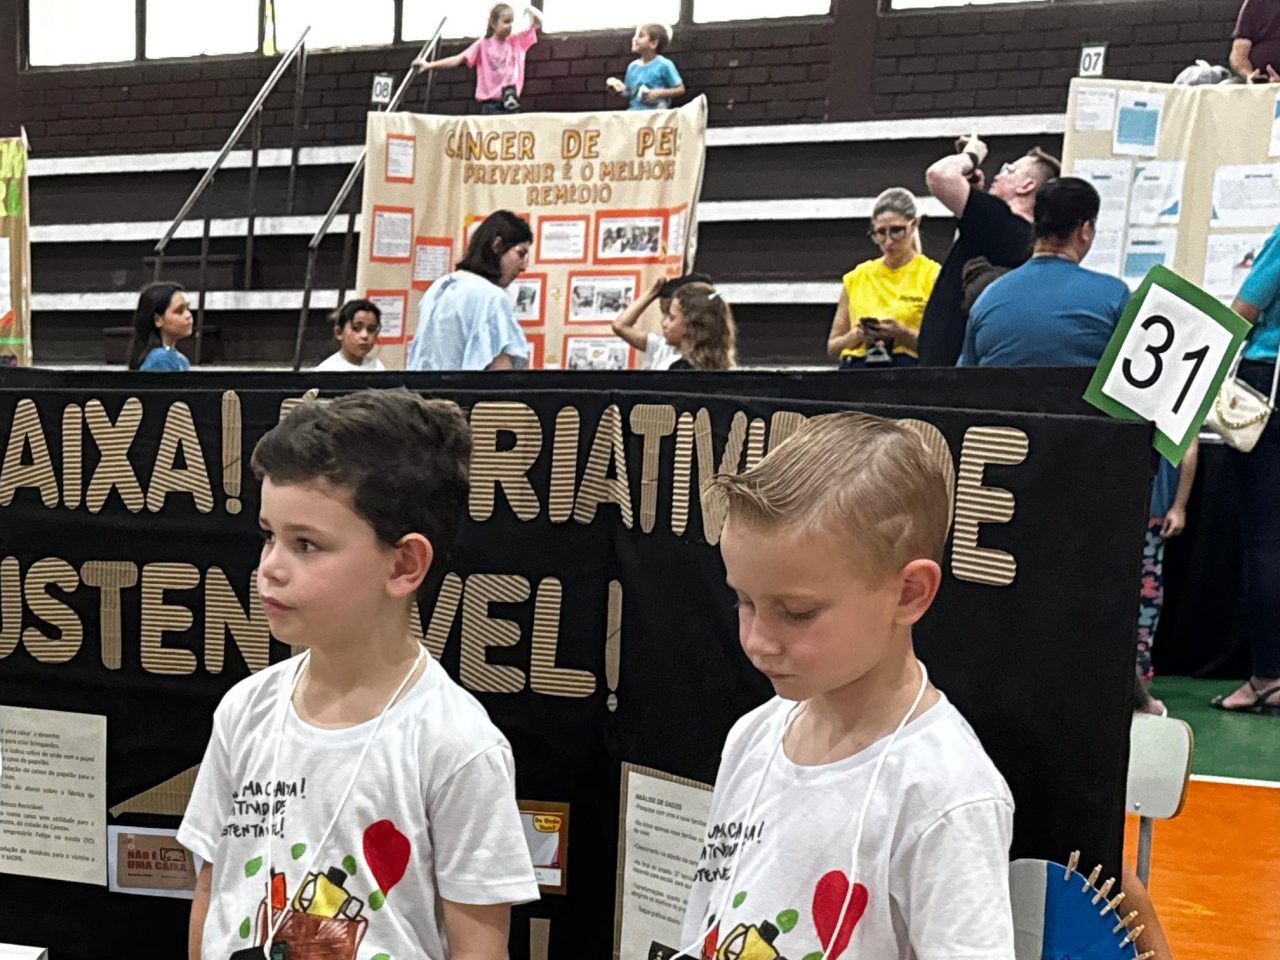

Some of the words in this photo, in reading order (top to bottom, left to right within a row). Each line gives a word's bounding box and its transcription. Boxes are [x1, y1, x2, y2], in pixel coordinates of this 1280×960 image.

[1081, 52, 1102, 73] 07
[375, 80, 390, 99] 08
[562, 128, 600, 160] DE
[637, 127, 679, 157] PE
[464, 163, 555, 184] PREVENIR
[563, 159, 571, 181] É
[580, 162, 593, 181] O
[599, 160, 675, 182] MELHOR
[527, 183, 611, 206] REMÉDIO
[1121, 314, 1211, 415] 31
[127, 861, 152, 870] UMA
